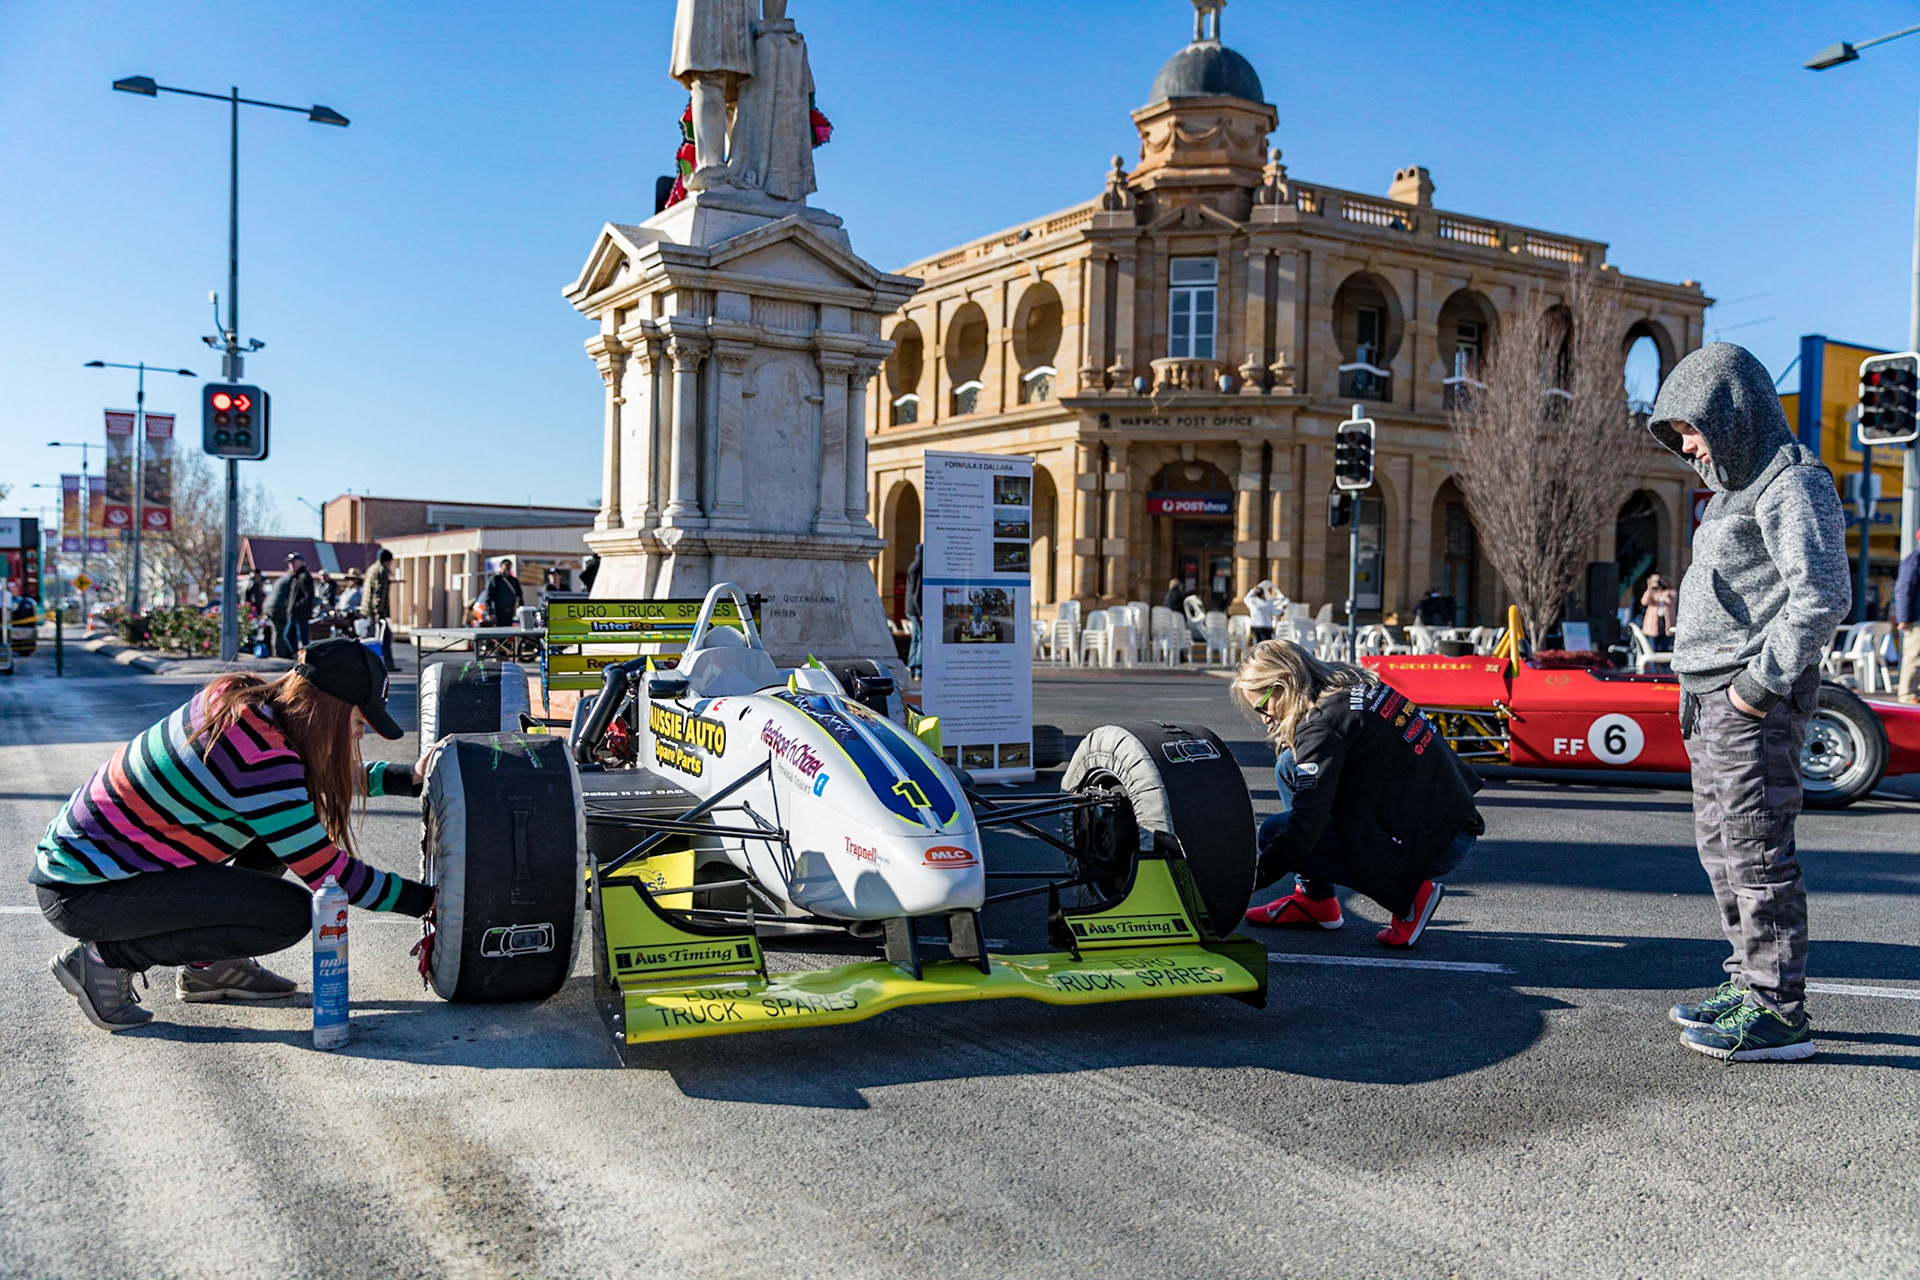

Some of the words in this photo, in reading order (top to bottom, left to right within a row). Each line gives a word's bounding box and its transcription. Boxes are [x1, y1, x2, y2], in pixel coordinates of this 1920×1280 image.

[1120, 417, 1170, 427] WARWICK
[1177, 417, 1206, 427] POST
[1213, 416, 1252, 426] OFFICE
[945, 461, 977, 469] FORMULA
[984, 463, 1014, 471] DALLARA
[783, 594, 836, 604] QUEENSLAND
[568, 605, 607, 618] EURO
[620, 605, 666, 618] TRUCK
[678, 605, 731, 618] SPAES
[649, 704, 683, 741] AUSSIE
[684, 717, 725, 754] AUTO
[1604, 724, 1627, 755] 6
[655, 739, 676, 764] Spare
[676, 748, 702, 774] Parts
[891, 780, 932, 808] 1
[845, 836, 877, 863] Trapnell
[931, 850, 966, 860] MLC
[1089, 922, 1117, 934] Aus
[1116, 920, 1171, 934] Timing
[635, 952, 667, 965] Aus
[668, 947, 732, 961] Timing
[1113, 956, 1176, 970] EURO
[1044, 972, 1126, 993] TRUCK
[1135, 966, 1223, 987] SPARES
[684, 989, 751, 1002] EURO
[655, 1002, 743, 1027] TRUCK
[762, 992, 859, 1018] SPARES
